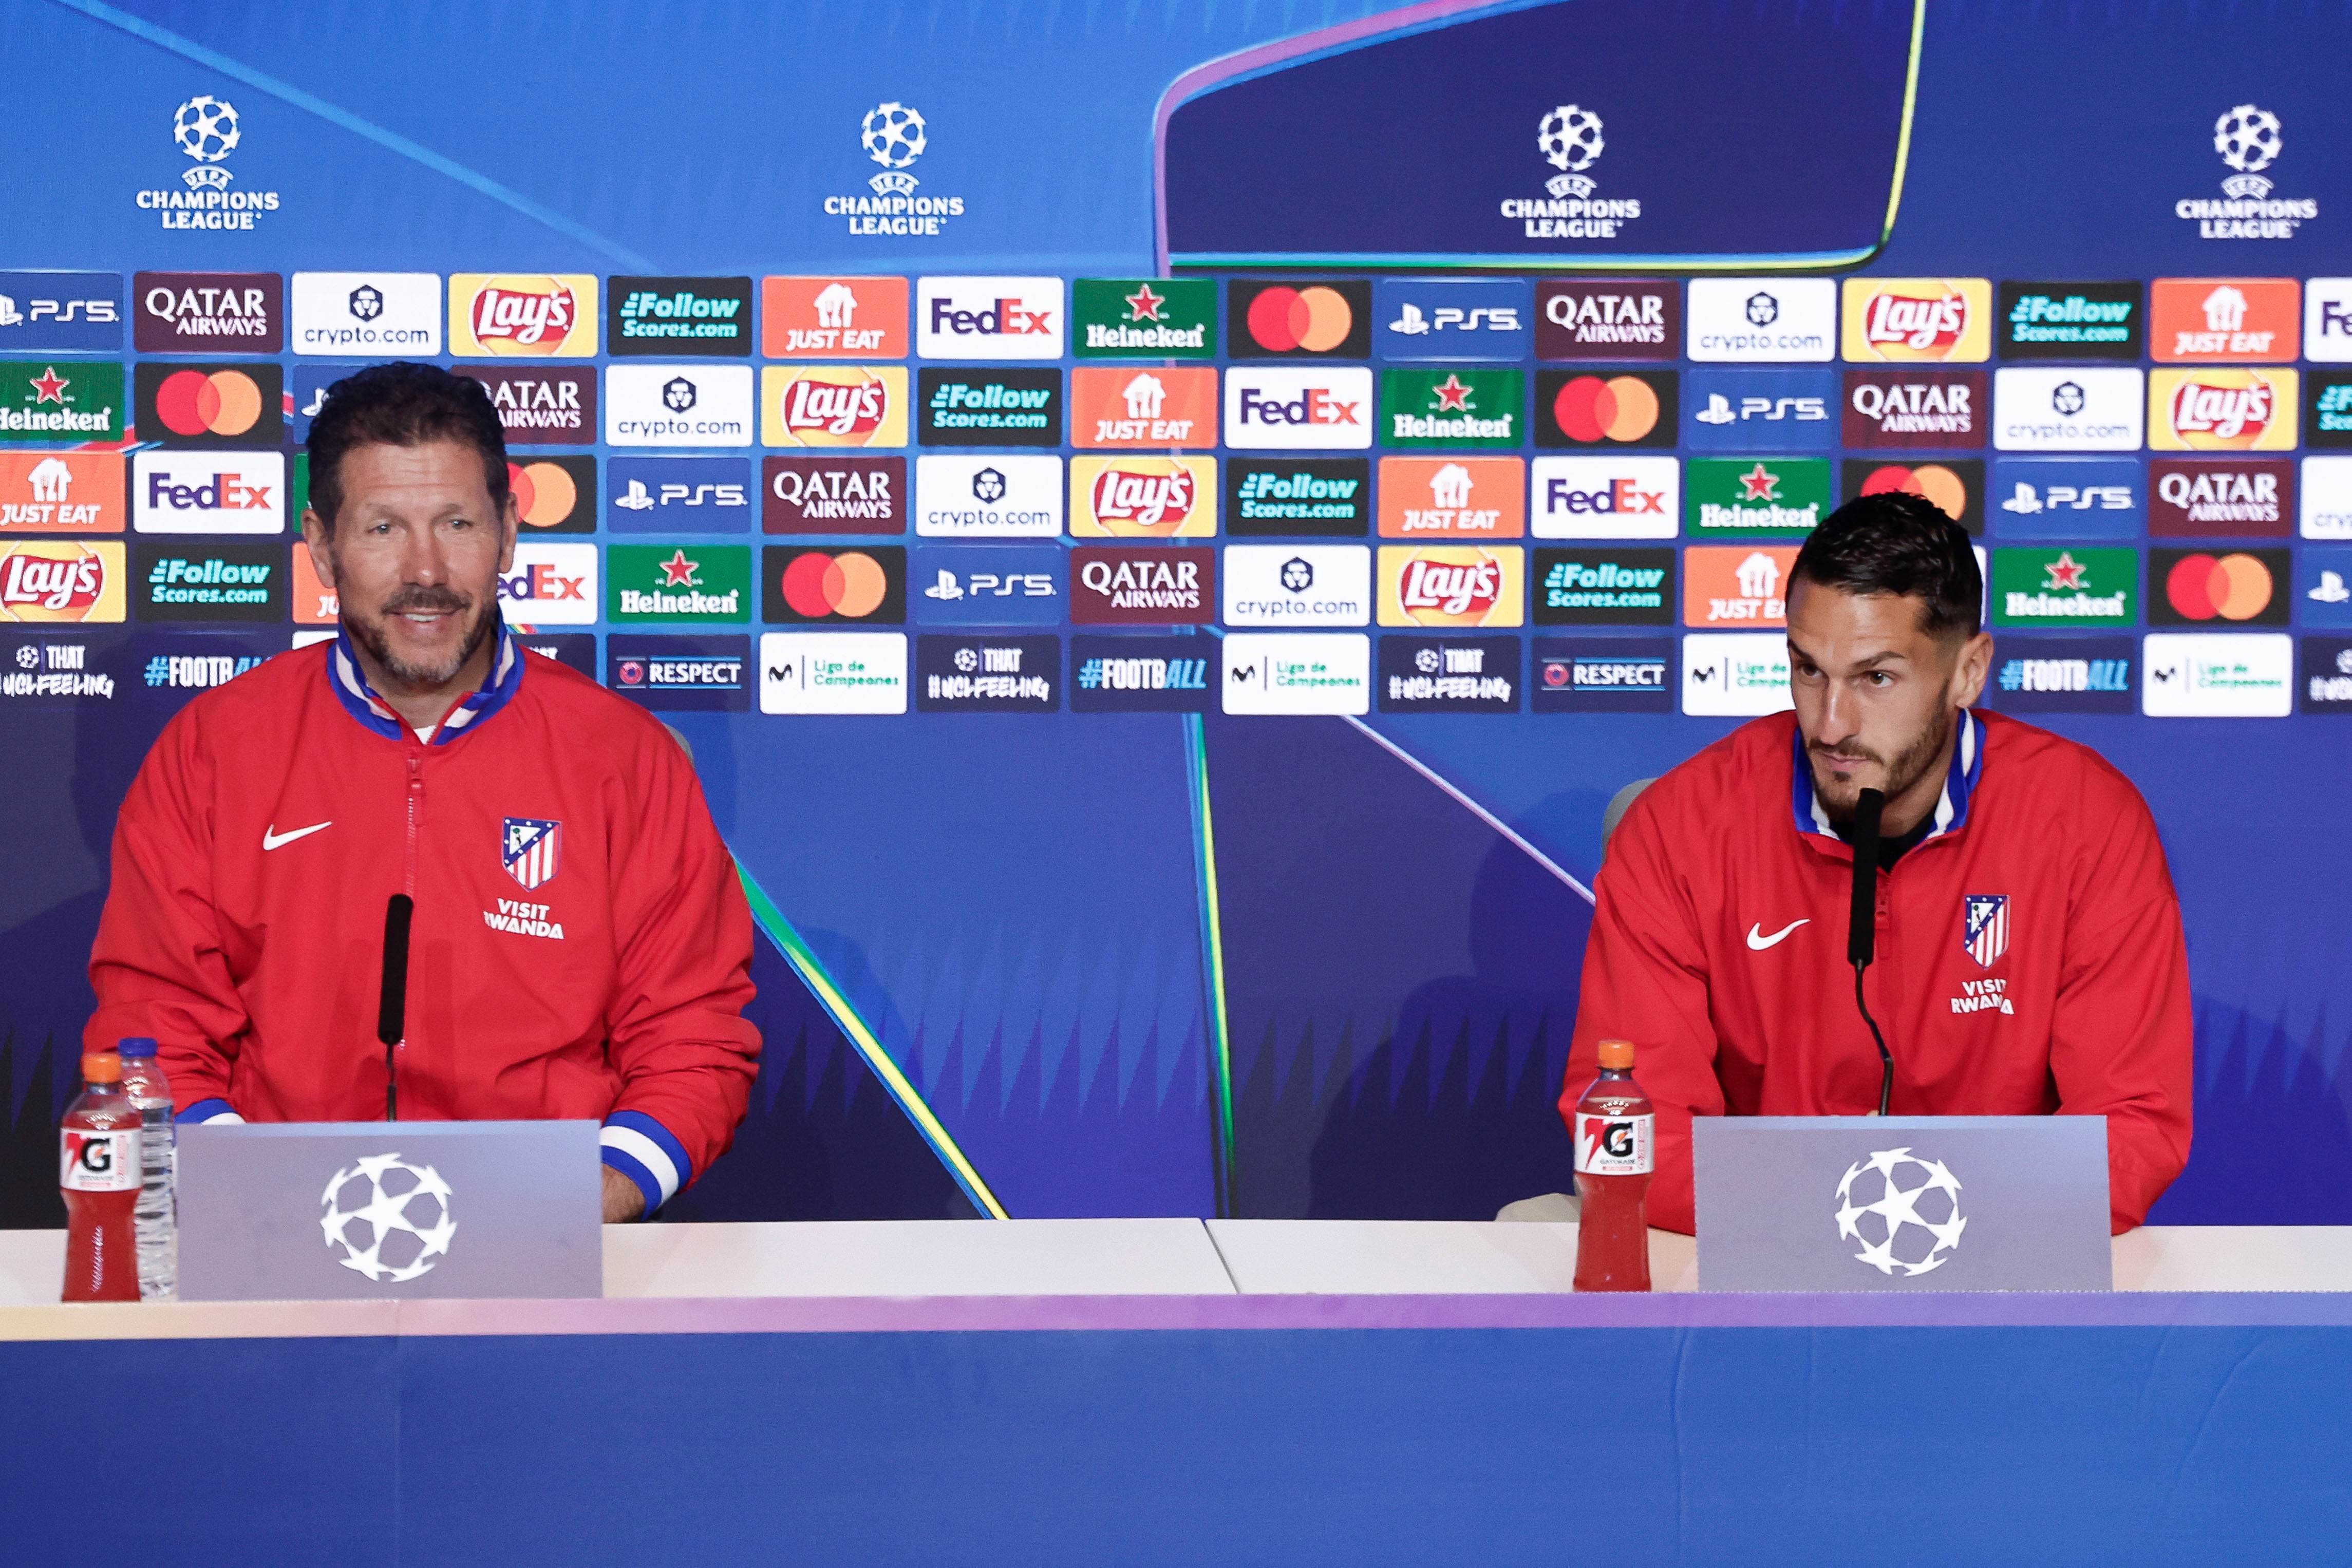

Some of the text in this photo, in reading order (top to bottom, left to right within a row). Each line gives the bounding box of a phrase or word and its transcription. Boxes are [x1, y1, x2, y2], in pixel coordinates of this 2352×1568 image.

[183, 171, 230, 186] UEFA
[872, 176, 915, 192] UEFA
[136, 191, 280, 210] CHAMPIONS
[824, 196, 965, 216] CHAMPIONS
[1500, 199, 1641, 218] CHAMPIONS
[2175, 199, 2318, 218] CHAMPIONS
[162, 211, 254, 230] LEAGUE
[849, 217, 939, 235] LEAGUE
[1526, 219, 1616, 237] LEAGUE
[2200, 219, 2293, 238] LEAGUE
[30, 298, 116, 323] PS5
[144, 288, 267, 319] QATAR
[636, 292, 741, 318] Follow
[1546, 295, 1664, 328] QATAR
[2027, 296, 2133, 323] Follow
[176, 317, 268, 336] AIRWAYS
[477, 290, 570, 344] Lay's
[931, 297, 1052, 335] FedEx
[1434, 308, 1518, 331] PS5
[1870, 292, 1963, 350] Lay's
[305, 326, 430, 346] crypto.com
[622, 319, 739, 338] Scores.com
[1085, 324, 1205, 349] Heineken
[1575, 325, 1665, 344] AIRWAYS
[785, 330, 886, 351] JUST EAT
[1700, 334, 1823, 350] crypto.com
[2174, 332, 2276, 355] JUST EAT
[481, 379, 582, 409] ATAR
[948, 384, 1051, 409] Follow
[1852, 384, 1970, 417] QATAR
[789, 382, 882, 435] Lay's
[1240, 388, 1360, 426] FedEx
[1741, 397, 1825, 421] PS5
[2177, 383, 2272, 439] Lay's
[618, 418, 742, 439] crypto.com
[932, 411, 1048, 429] Scores.com
[1094, 420, 1194, 442] JUST EAT
[1394, 414, 1513, 438] Heineken
[1880, 413, 1972, 433] AIRWAYS
[2007, 423, 2130, 441] crypto.com
[148, 473, 272, 511] FedEx
[660, 485, 744, 507] PS5
[773, 471, 891, 505] QATAR
[1099, 471, 1191, 525] Lay's
[1254, 473, 1359, 500] Follow
[1547, 478, 1667, 515] FedEx
[2158, 473, 2279, 506] QATAR
[801, 498, 893, 519] AIRWAYS
[1240, 500, 1355, 519] Scores.com
[2047, 486, 2132, 511] PS5
[0, 503, 102, 526] JUST EAT
[927, 510, 1050, 526] crypto.com
[1402, 510, 1501, 532] JUST EAT
[1699, 501, 1819, 528] Heineken
[3, 555, 99, 610] Lay's
[165, 558, 272, 584] Follow
[1081, 560, 1200, 594] QATAR
[1563, 563, 1666, 588] Follow
[151, 585, 268, 604] Scores.com
[969, 574, 1053, 597] PS5
[1403, 560, 1498, 614] Lay's
[316, 595, 340, 618] JU
[619, 589, 739, 613] Heineken
[1110, 590, 1201, 609] AIRWAYS
[1235, 598, 1358, 615] crypto.com
[1546, 590, 1662, 609] Scores.com
[1707, 598, 1762, 620] JUST
[2005, 591, 2127, 617] Heineken
[46, 645, 86, 670] THAT
[813, 659, 865, 674] Liga de
[982, 648, 1022, 673] THAT
[1310, 662, 1327, 672] de
[1444, 648, 1484, 674] THAT
[648, 662, 741, 684] RESPECT
[1077, 657, 1208, 690] #FOOTBALL
[1573, 663, 1666, 686] RESPECT
[1998, 658, 2130, 692] #FOOTBALL
[0, 672, 115, 700] UCLFEELING
[927, 674, 1050, 702] #UCLFEELING
[497, 898, 551, 921] VISIT
[1603, 1122, 1633, 1158] G
[82, 1138, 111, 1173] G
